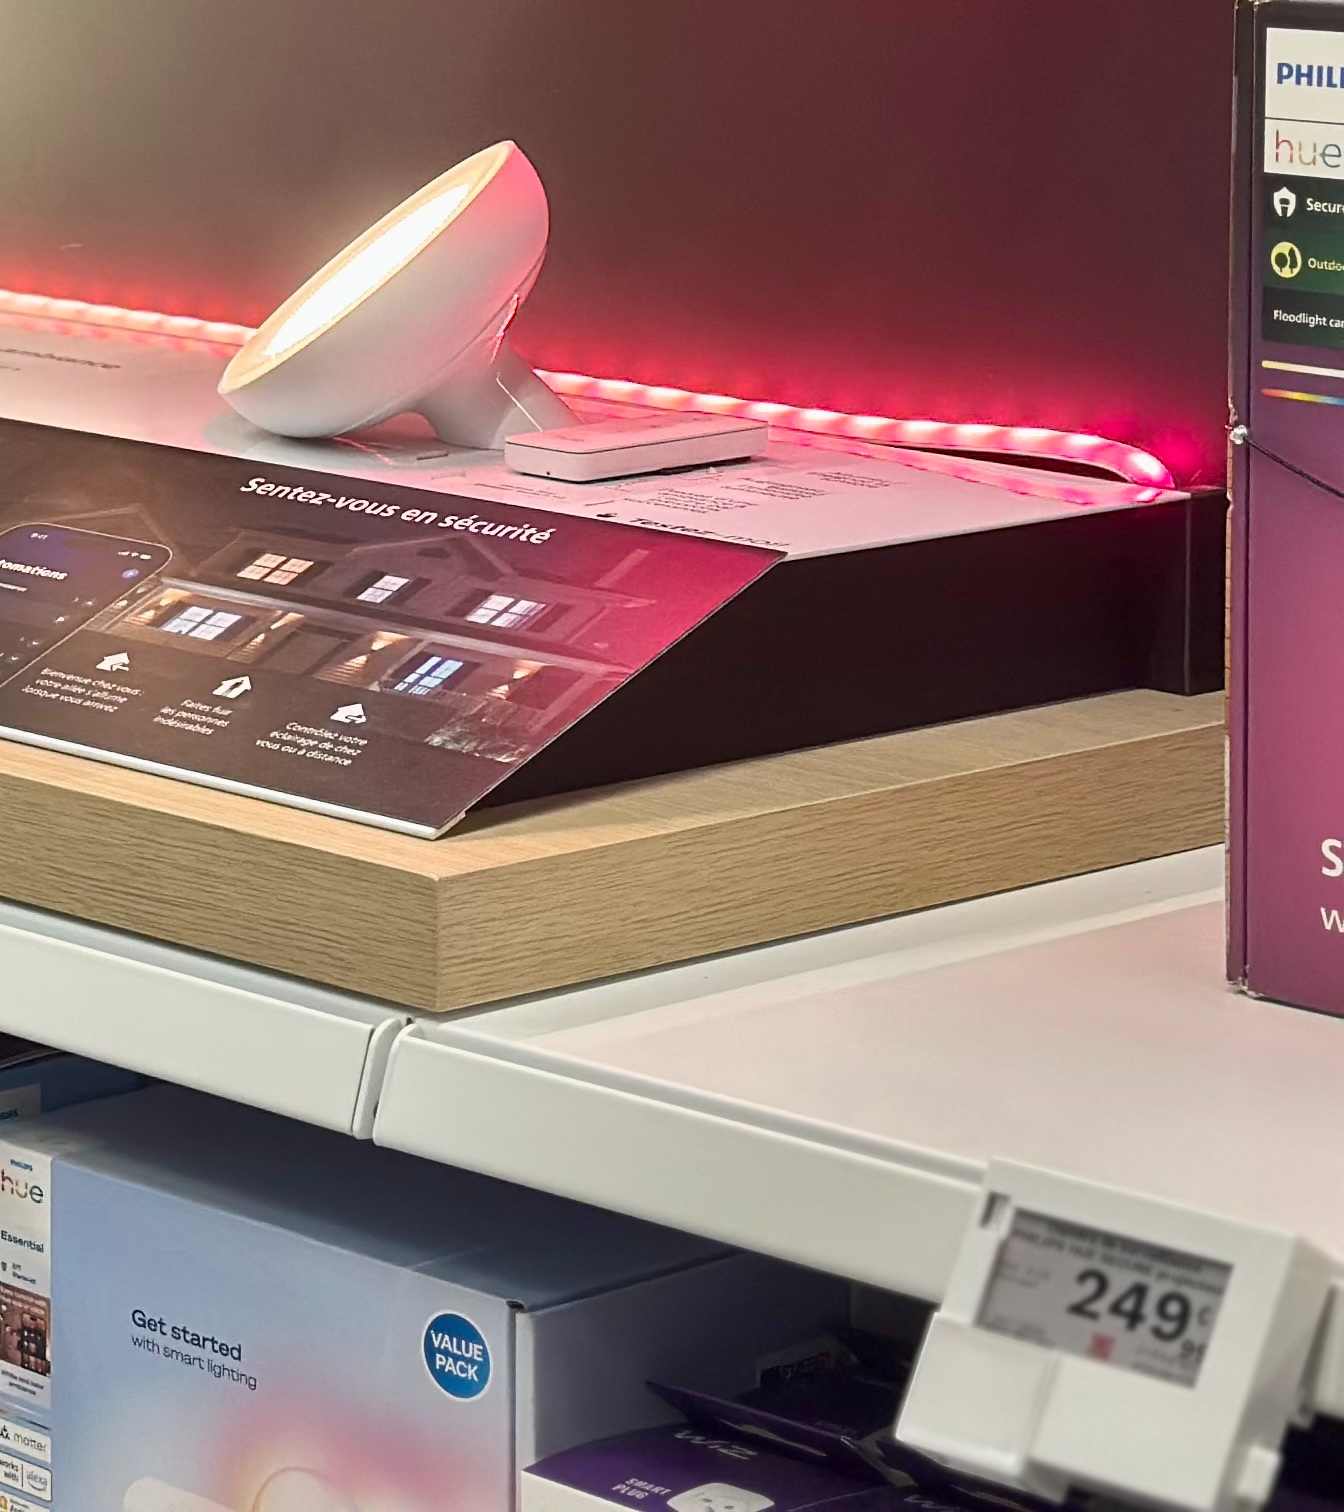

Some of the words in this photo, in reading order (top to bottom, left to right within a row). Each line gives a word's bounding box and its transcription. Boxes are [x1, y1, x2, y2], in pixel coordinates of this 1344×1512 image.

[1275, 129, 1342, 169] hue
[1273, 309, 1327, 329] Floodlight
[240, 477, 401, 518] Sentez-vous
[400, 506, 439, 526] en
[438, 514, 557, 545] sécurité
[36, 678, 62, 691] votre
[85, 688, 128, 704] s'allume
[41, 668, 91, 686] Bienvenue
[91, 677, 117, 691] chez
[22, 686, 60, 700] lorsque
[59, 696, 83, 706] vous
[82, 699, 119, 713] arrivez
[181, 699, 212, 713] Faites
[212, 706, 233, 717] fuir
[153, 715, 214, 736] indésirables
[160, 706, 175, 717] les
[174, 710, 230, 728] personnes
[270, 730, 318, 747] éclairage
[318, 741, 334, 750] de
[334, 744, 362, 757] chez
[285, 721, 339, 739] Contrôlez
[338, 733, 368, 747] votre
[255, 739, 281, 751] vous
[281, 745, 297, 754] ou
[297, 747, 306, 756] à
[305, 749, 353, 767] distance
[0, 1168, 44, 1204] hue
[0, 1229, 45, 1253] Essential
[1069, 1244, 1096, 1258] HUE
[131, 1309, 168, 1336] Get
[171, 1325, 242, 1362] started
[431, 1330, 484, 1361] VALUE
[132, 1334, 161, 1355] with
[163, 1346, 205, 1370] smart
[207, 1358, 257, 1391] lighting
[435, 1353, 479, 1382] PACK
[13, 1431, 47, 1453] matter
[26, 1469, 48, 1486] alexa
[626, 1478, 672, 1495] SMART
[612, 1484, 649, 1500] PLUG
